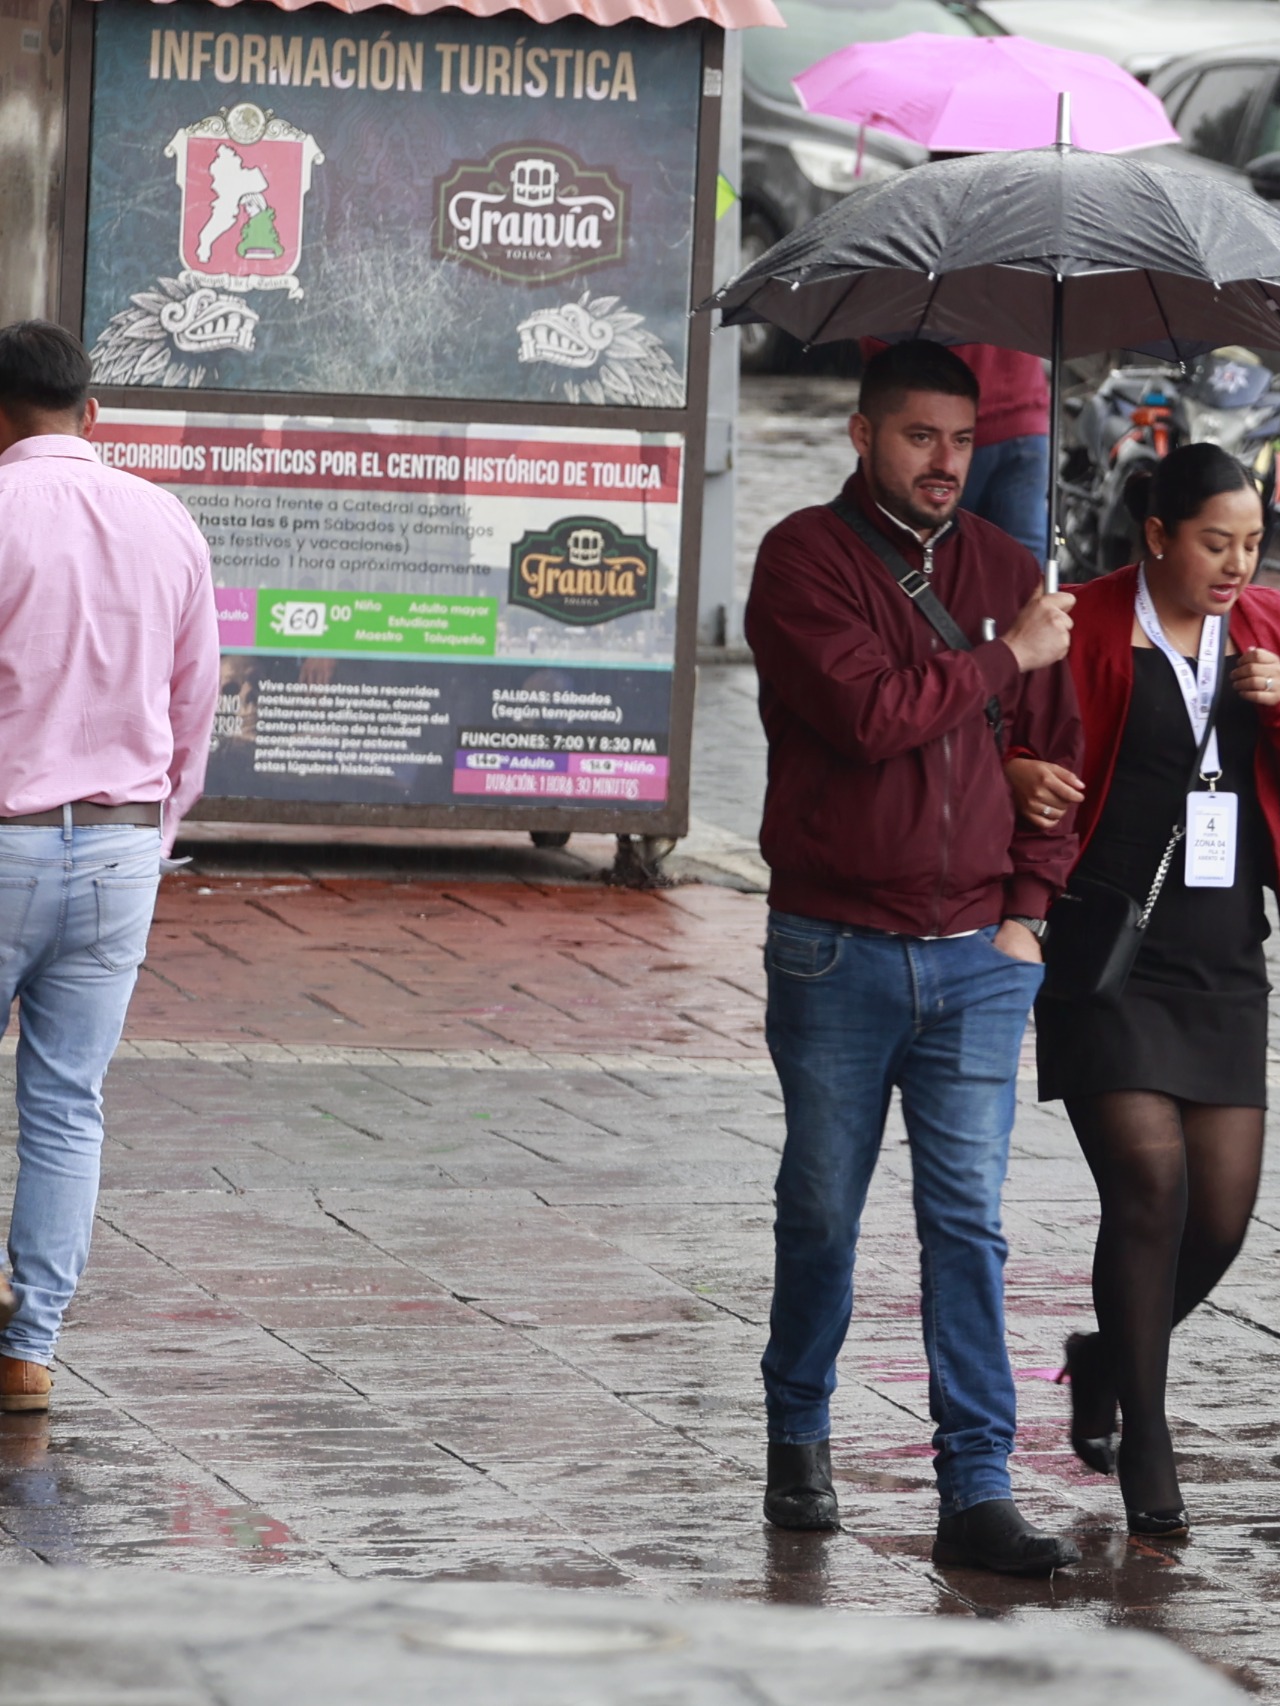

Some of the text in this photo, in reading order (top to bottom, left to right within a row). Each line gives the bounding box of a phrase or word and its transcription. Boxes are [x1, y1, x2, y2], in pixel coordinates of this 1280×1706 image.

[149, 29, 424, 92] INFORMACIÓN
[435, 37, 637, 101] TURÍSTICA
[448, 190, 616, 250] Tranvía
[506, 250, 552, 260] TOLUCA
[210, 443, 317, 475] TURÍSTICOS
[320, 450, 357, 477] POR
[361, 452, 384, 478] EL
[387, 453, 461, 481] CENTRO
[463, 454, 560, 486] HISTÓRICO
[563, 461, 588, 487] DE
[591, 462, 662, 490] TOLUCA
[187, 494, 230, 508] cada
[234, 494, 272, 509] hora
[277, 495, 324, 511] frente
[328, 502, 338, 512] a
[343, 499, 414, 514] Catedral
[200, 512, 247, 528] hasta
[251, 514, 275, 528] las
[279, 516, 289, 528] 6
[293, 518, 320, 533] pm
[324, 518, 395, 533] Sábados
[399, 522, 409, 537] y
[413, 521, 494, 541] domingos
[230, 532, 292, 549] festivos
[296, 536, 306, 553] y
[310, 535, 410, 555] vacaciones)
[298, 554, 336, 570] hora
[521, 553, 647, 599] Tranvía
[354, 599, 490, 618] Niño Adulto mayor
[388, 615, 449, 629] Estudiante
[354, 629, 404, 642] Maestro
[258, 679, 440, 698] Vive con nosotros los recorridos
[491, 689, 612, 706] SALIDAS: Sábados
[257, 694, 317, 707] nocturnos
[318, 695, 334, 708] de
[392, 698, 431, 711] donde
[257, 706, 326, 720] visitaremos
[377, 711, 429, 725] antiguos
[430, 713, 450, 725] del
[491, 702, 623, 724] (Según temporada)
[256, 720, 297, 733] Centro
[350, 723, 366, 736] de
[366, 723, 379, 736] la
[380, 724, 422, 738] ciudad
[341, 737, 361, 751] por
[362, 738, 408, 750] actores
[460, 731, 657, 754] FUNCIONES: 7:00 Y 8:30 PM
[253, 760, 287, 773] estas
[334, 751, 358, 764] que
[509, 755, 556, 771] Adulto
[624, 759, 656, 775] Niño
[546, 776, 574, 796] HORA
[576, 776, 591, 796] 30
[592, 777, 640, 800] MINUTOS
[1206, 817, 1216, 833] 4
[1194, 839, 1216, 848] ZONA
